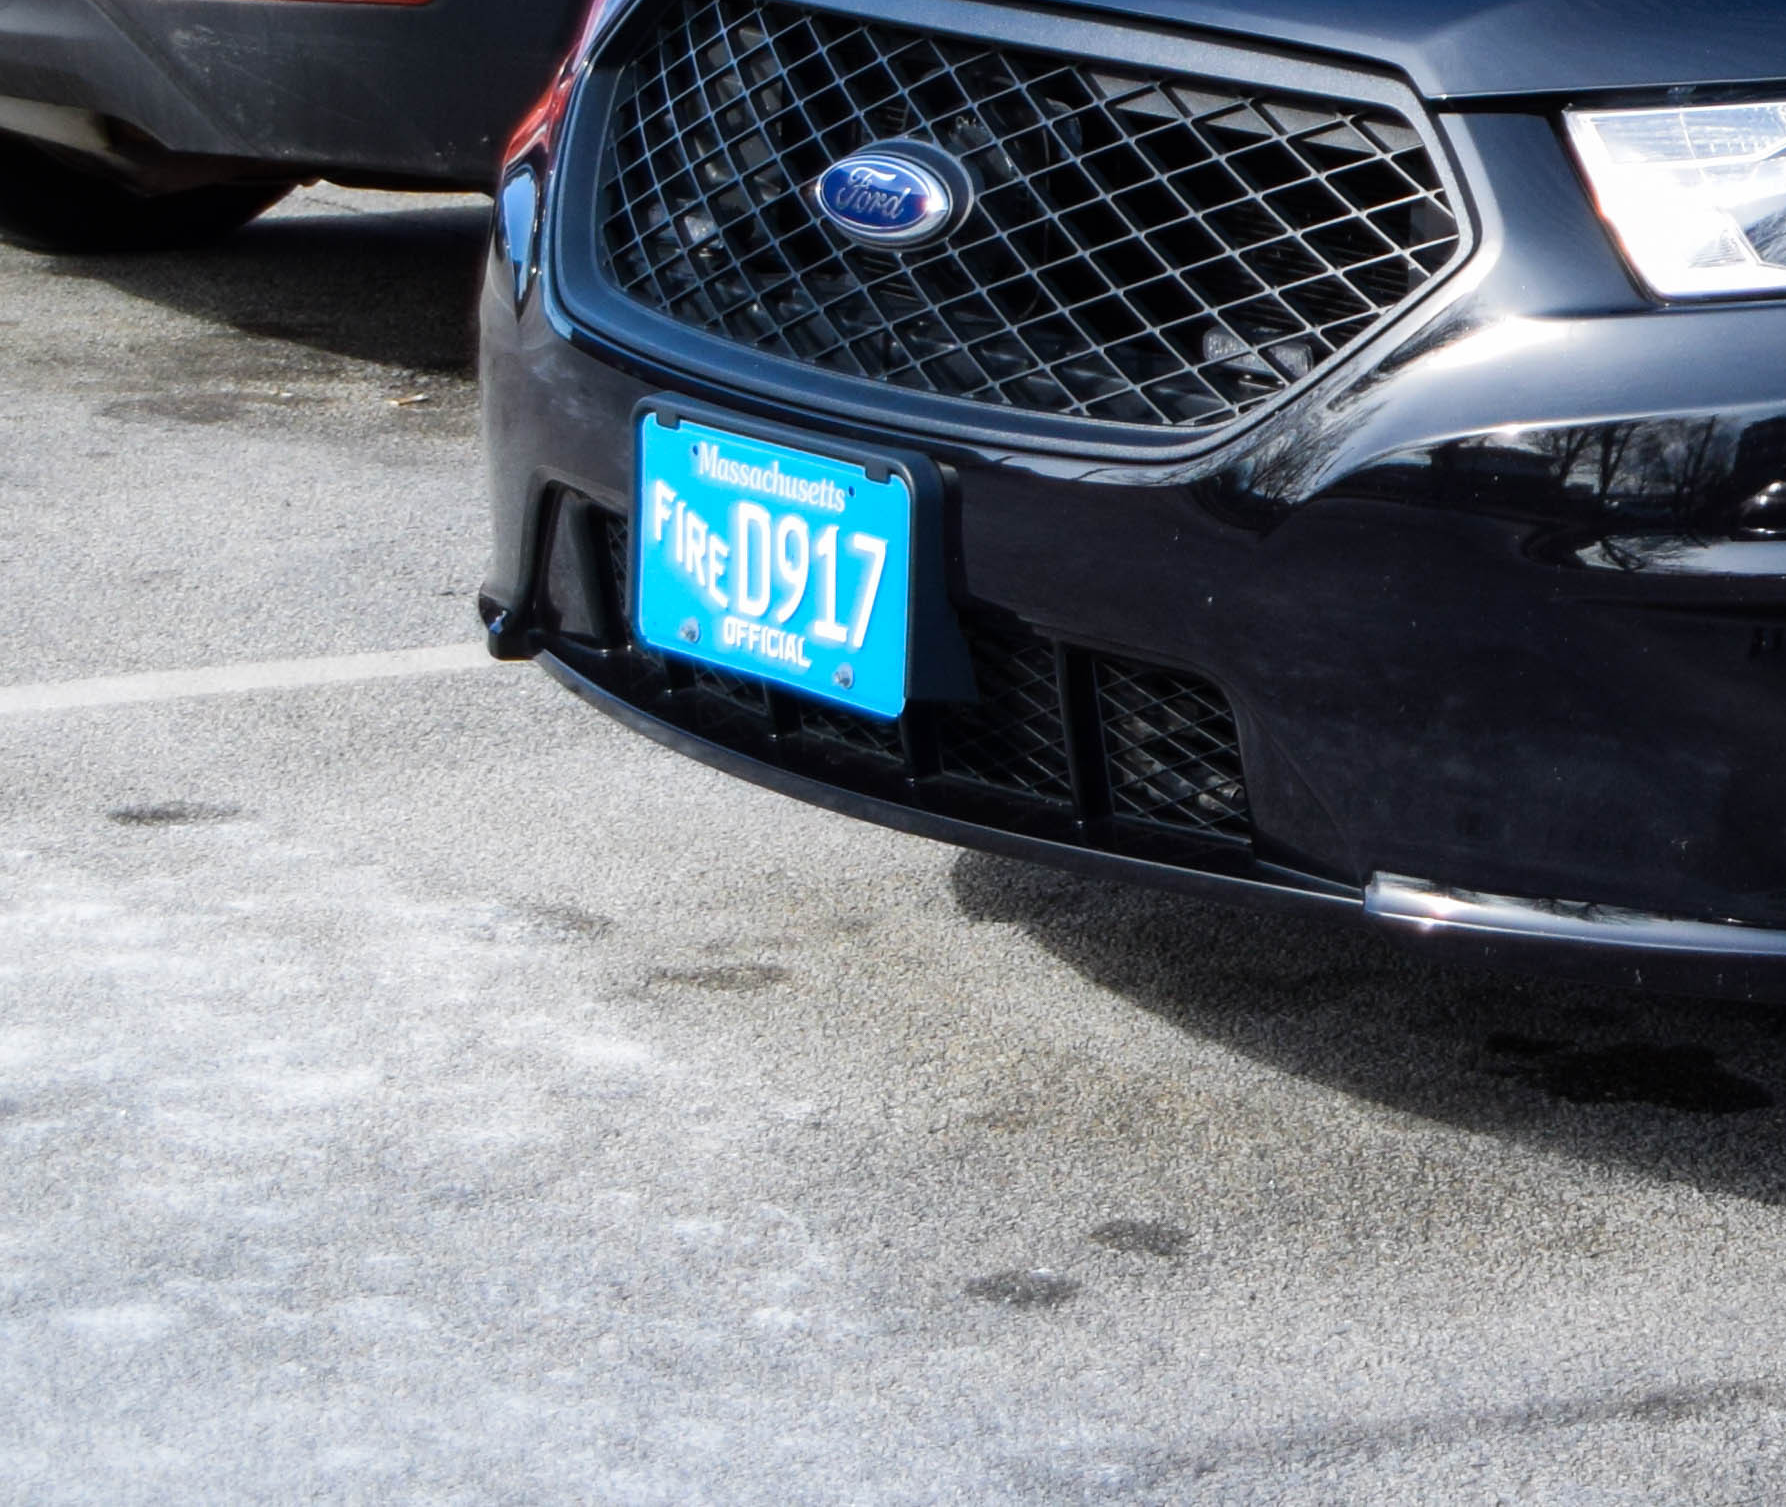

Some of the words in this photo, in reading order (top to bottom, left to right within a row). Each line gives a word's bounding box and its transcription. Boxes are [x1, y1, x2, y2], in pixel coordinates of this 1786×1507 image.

[836, 166, 912, 220] Ford
[699, 440, 846, 513] Massachusetts
[654, 479, 730, 609] FIRE
[736, 500, 888, 649] D917
[722, 615, 812, 669] OFFICIAL
